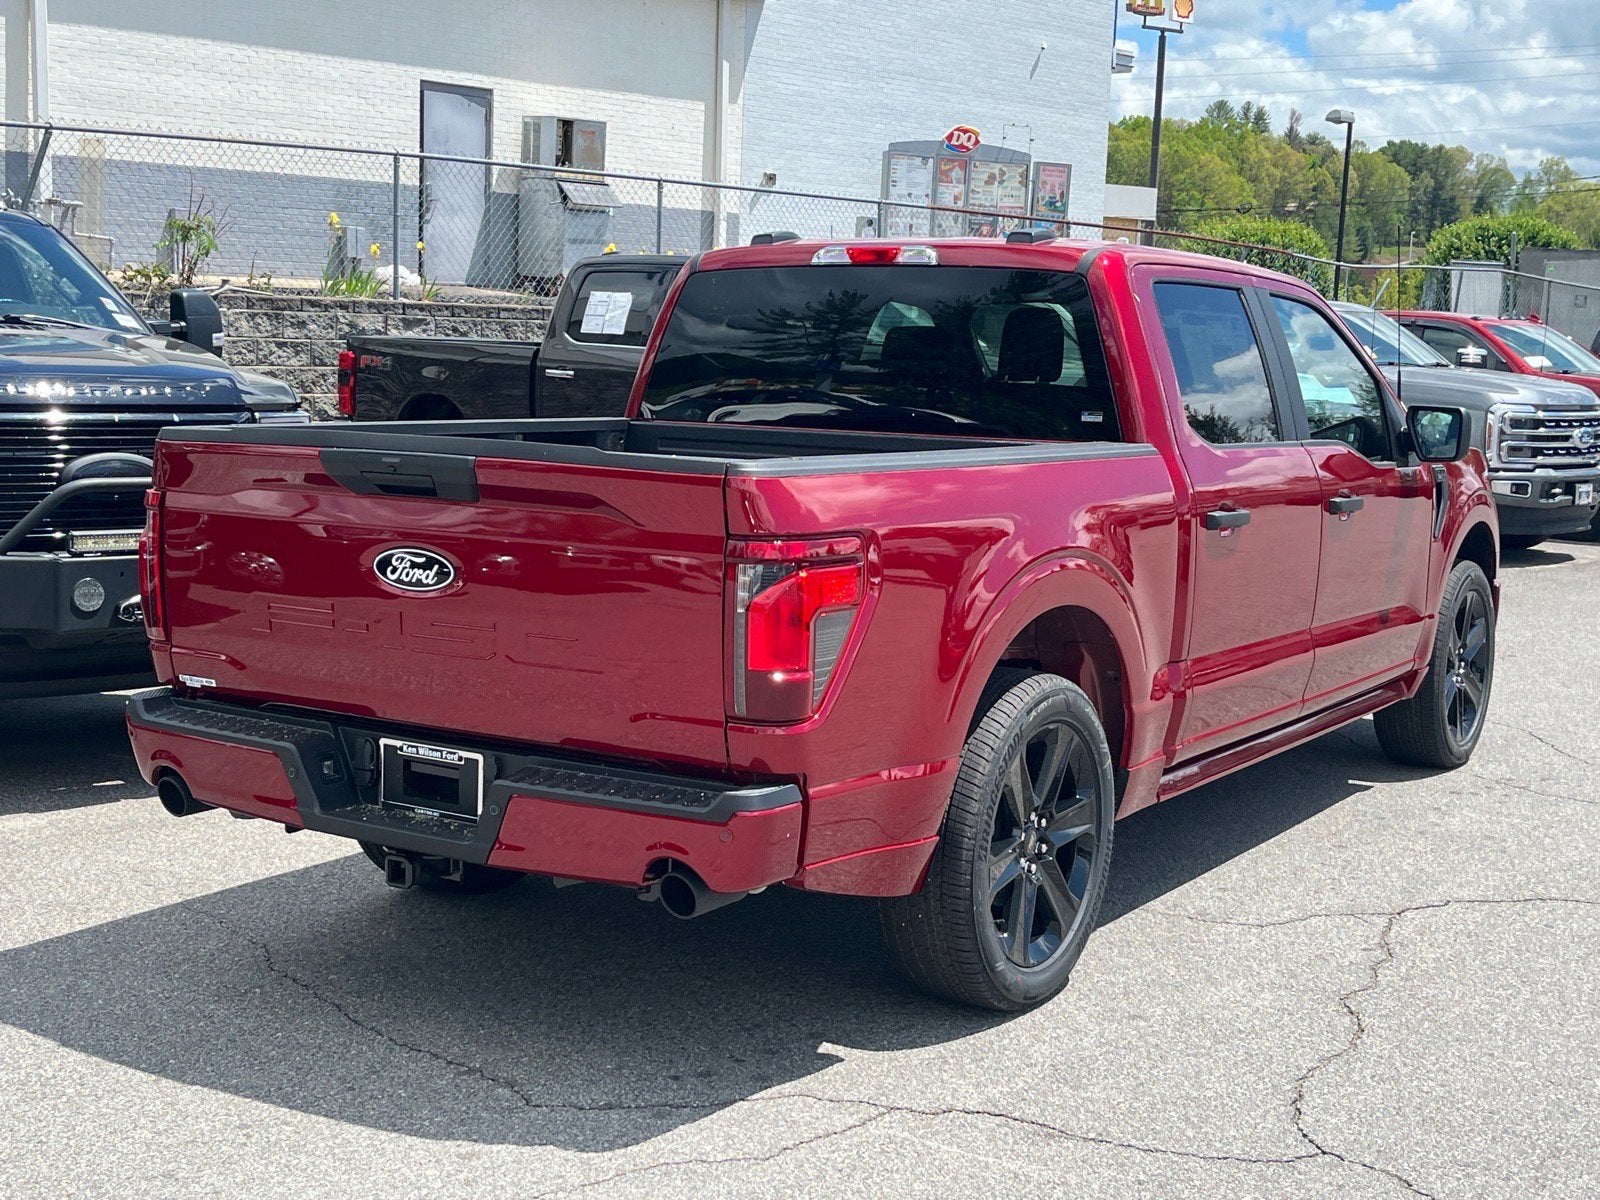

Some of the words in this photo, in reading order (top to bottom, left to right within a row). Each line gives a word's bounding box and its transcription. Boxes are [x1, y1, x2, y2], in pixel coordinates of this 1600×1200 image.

[951, 131, 976, 148] DQ
[361, 355, 392, 370] FX4
[386, 553, 439, 585] Ford
[403, 744, 417, 755] Ken
[418, 747, 441, 758] Wilson
[442, 751, 459, 761] Ford
